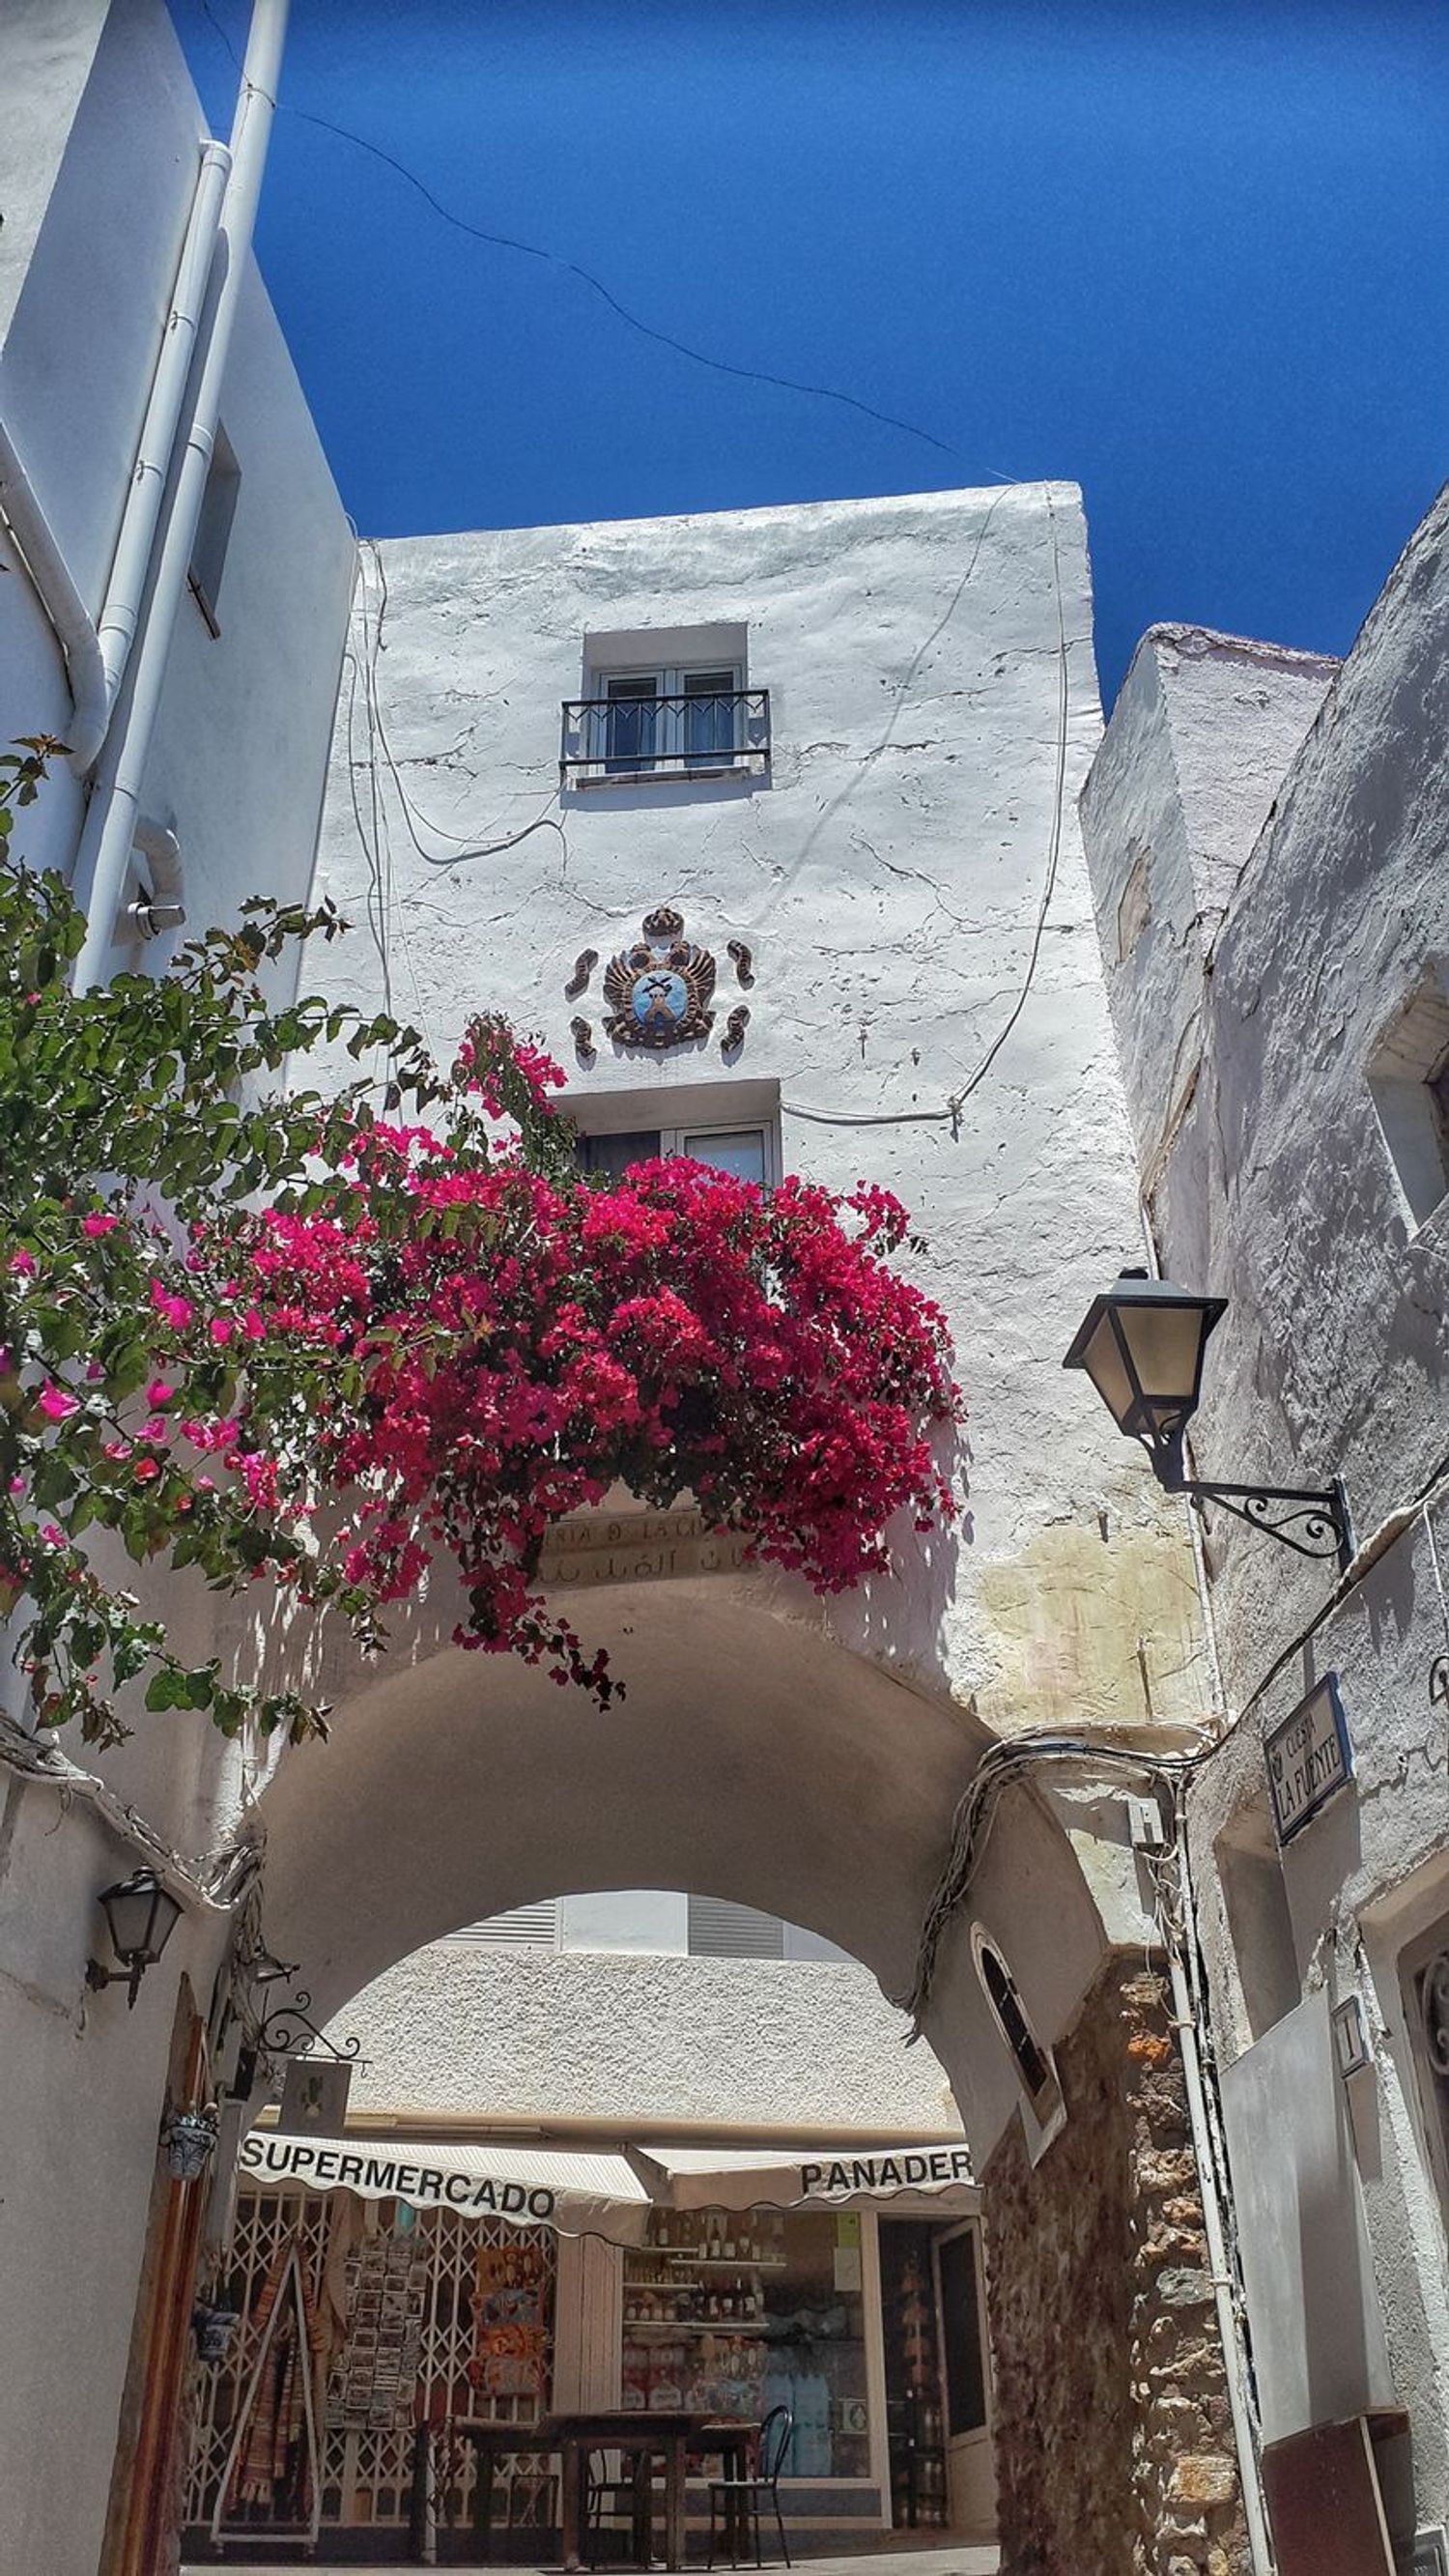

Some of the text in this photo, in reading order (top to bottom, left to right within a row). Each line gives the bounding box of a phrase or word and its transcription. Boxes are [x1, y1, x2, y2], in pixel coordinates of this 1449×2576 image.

[1277, 1735, 1341, 1819] LA FUENTE
[240, 2137, 556, 2218] SUPERMERCADO
[801, 2150, 975, 2194] PANADER
